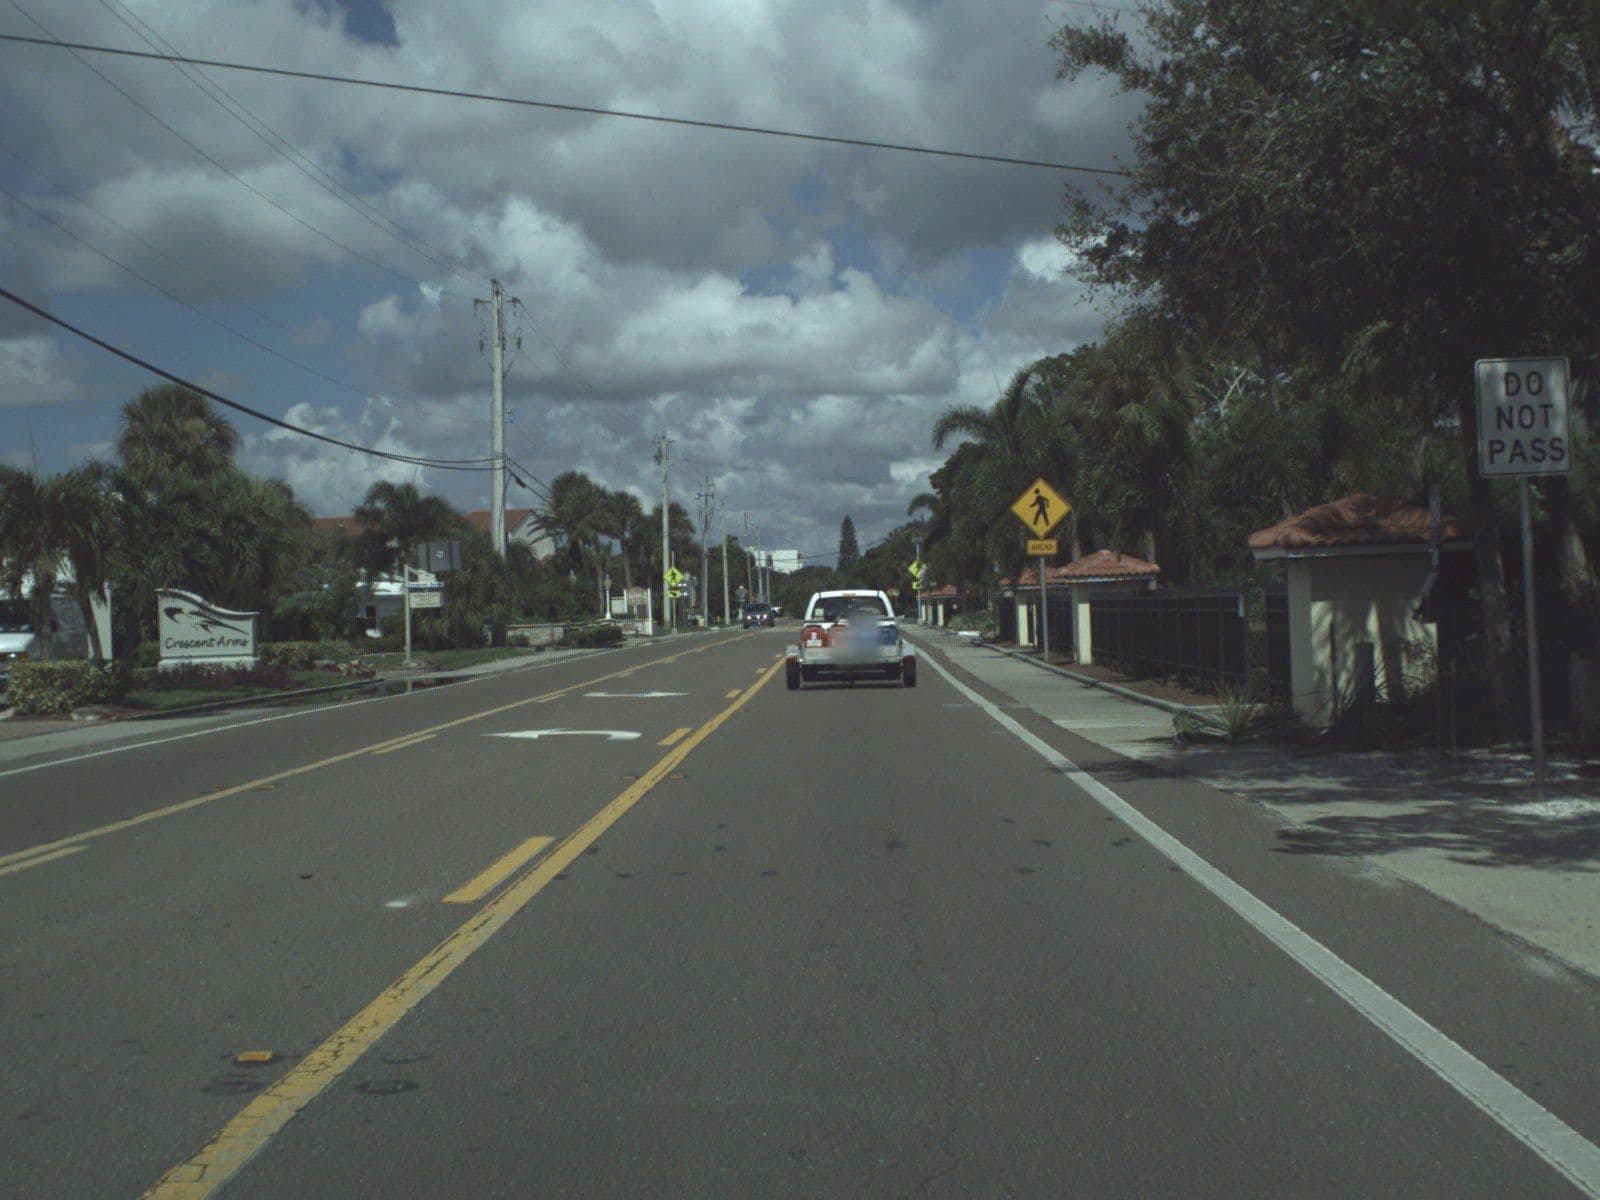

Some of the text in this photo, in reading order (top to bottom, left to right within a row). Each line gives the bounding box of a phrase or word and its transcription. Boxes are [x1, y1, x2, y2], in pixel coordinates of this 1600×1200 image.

[1504, 371, 1544, 397] DO
[1496, 404, 1554, 431] NOT
[1488, 437, 1565, 464] PASS
[164, 635, 249, 650] Crescent Arms
